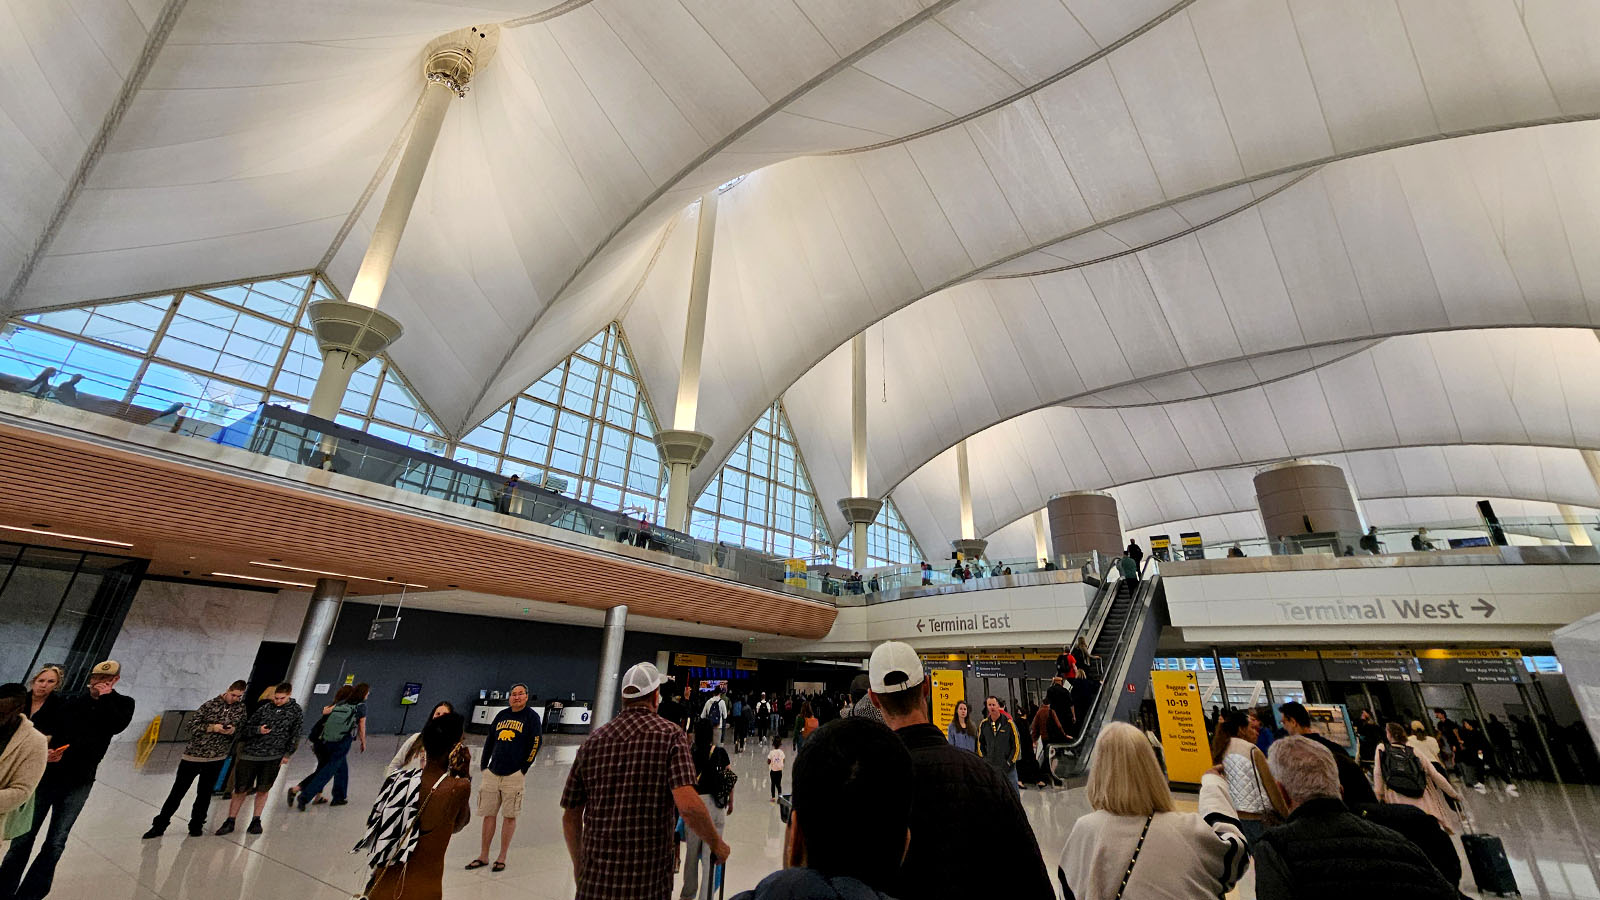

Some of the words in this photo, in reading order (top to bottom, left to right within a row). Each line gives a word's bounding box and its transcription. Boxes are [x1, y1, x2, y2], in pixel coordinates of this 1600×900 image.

[1276, 598, 1386, 621] Terminal
[1392, 598, 1464, 620] West
[928, 614, 978, 632] Terminal
[982, 613, 1010, 630] East
[496, 720, 523, 733] CALIFORNIA
